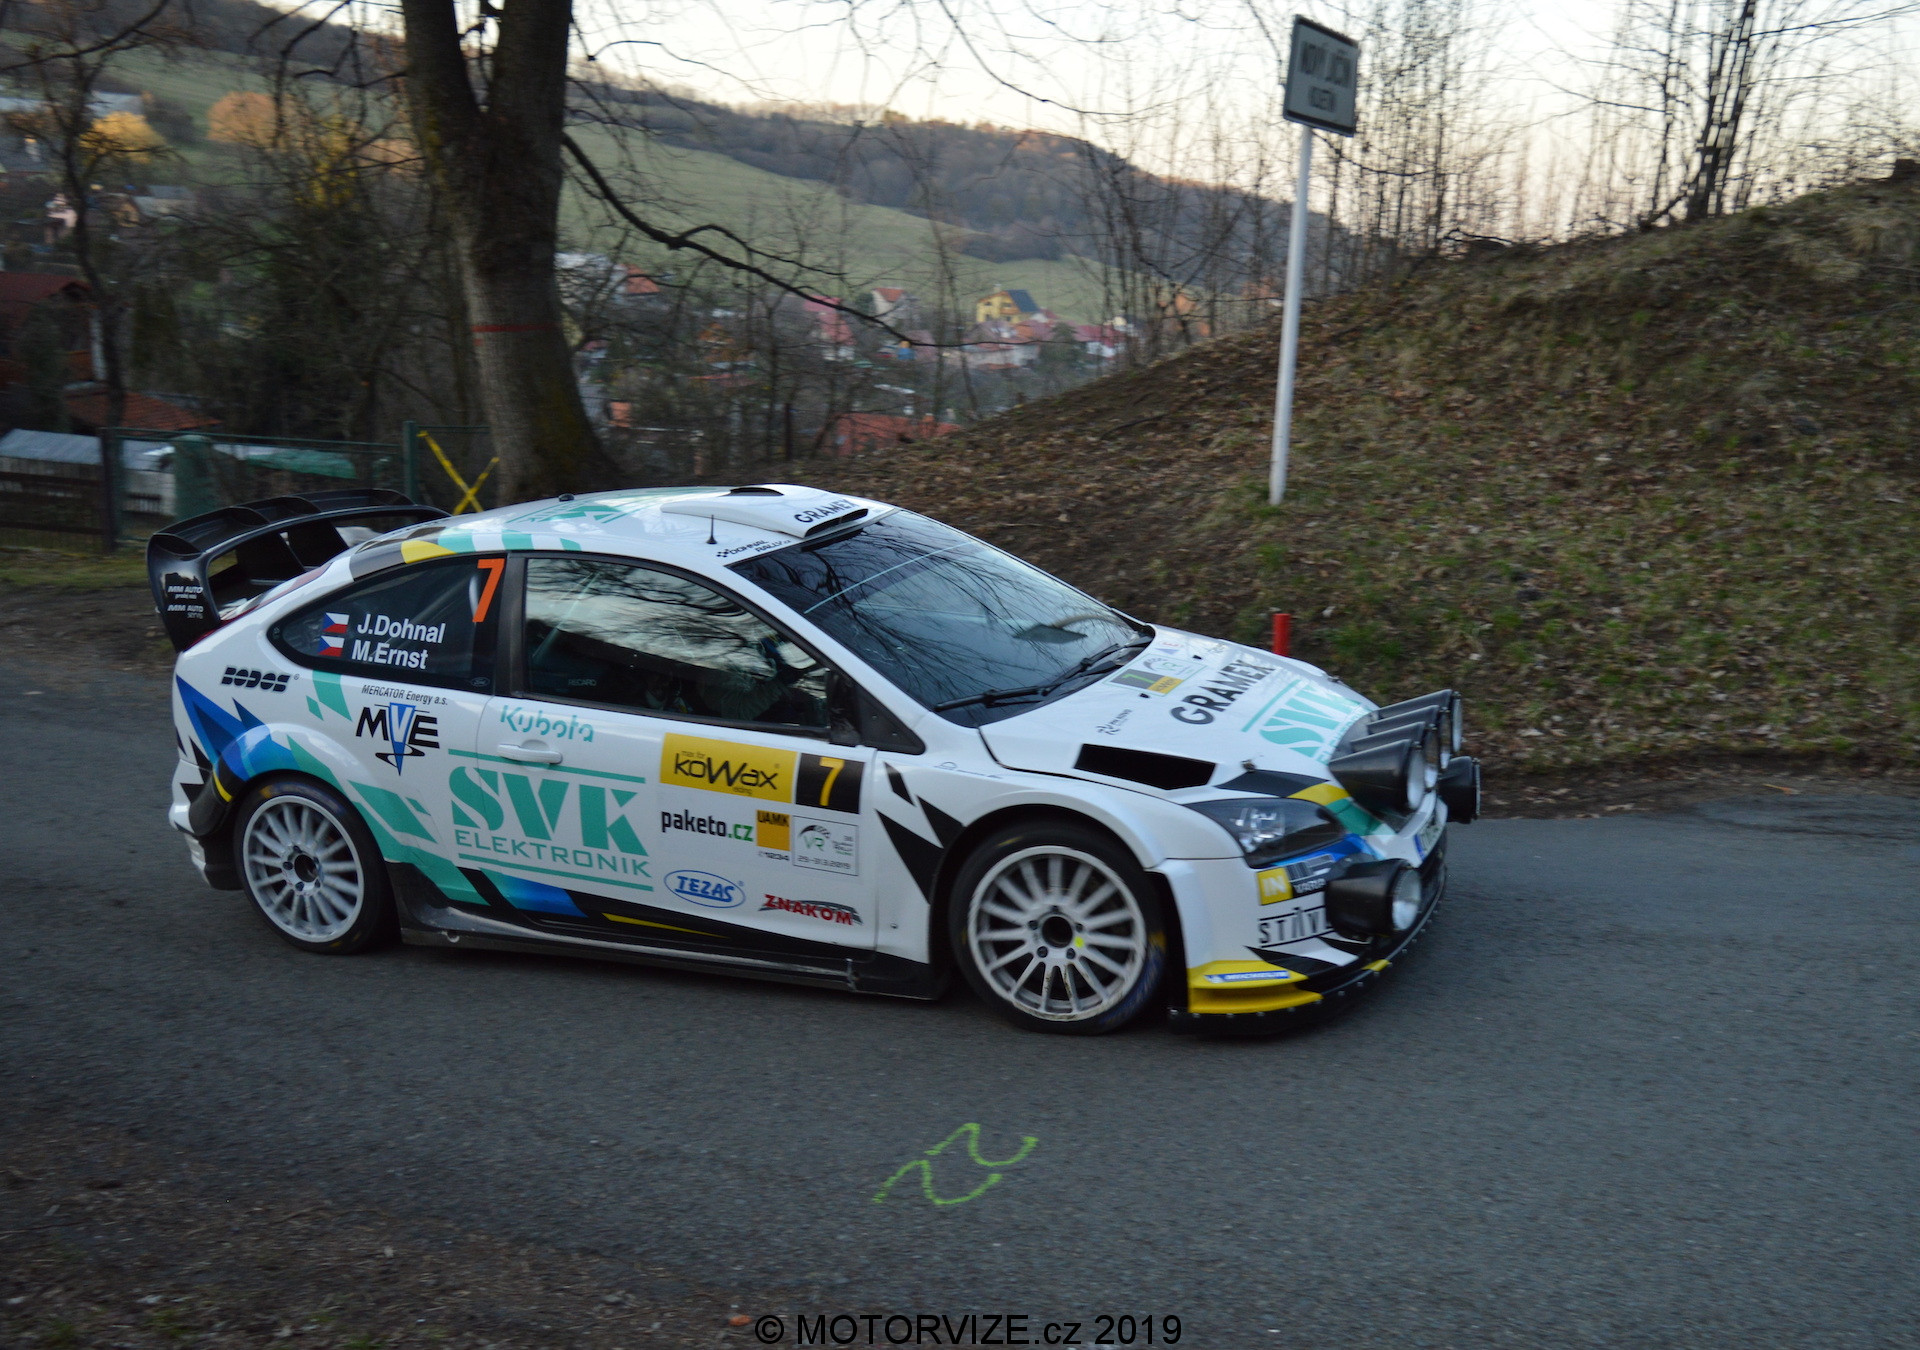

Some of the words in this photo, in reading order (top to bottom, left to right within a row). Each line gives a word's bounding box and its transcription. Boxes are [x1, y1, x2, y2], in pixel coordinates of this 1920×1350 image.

[794, 499, 859, 523] GRAMEX
[472, 558, 505, 623] 7
[357, 613, 446, 644] J.Dohnal
[352, 639, 429, 670] M.Ernst
[361, 684, 405, 699] MERCATOR
[406, 690, 434, 706] Energy
[434, 696, 448, 706] a.s.
[1169, 659, 1276, 725] GRAMEX
[355, 702, 440, 749] MVE
[500, 704, 594, 743] Kubota
[1260, 684, 1361, 758] SVK
[819, 756, 845, 807] 7
[448, 766, 649, 857] SVK
[661, 809, 754, 842] paketo.cz
[454, 829, 652, 878] ELEKTRONIK
[676, 875, 735, 902] TEZAS
[1262, 875, 1288, 897] IN
[764, 894, 853, 926] ZNAKOM
